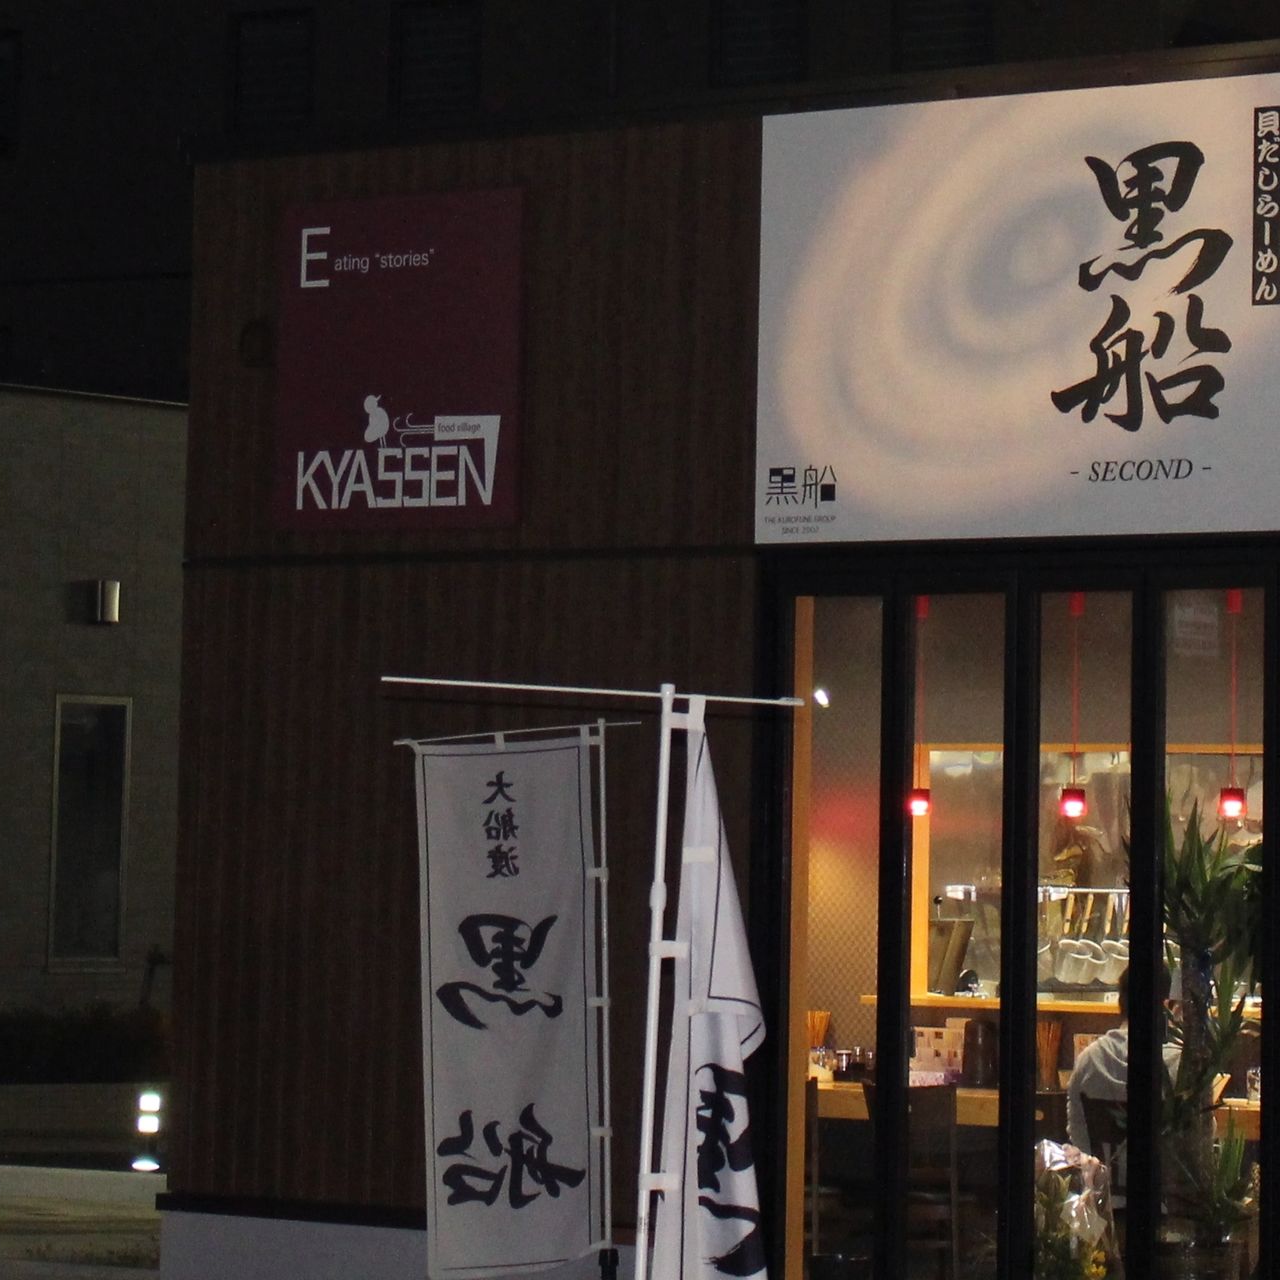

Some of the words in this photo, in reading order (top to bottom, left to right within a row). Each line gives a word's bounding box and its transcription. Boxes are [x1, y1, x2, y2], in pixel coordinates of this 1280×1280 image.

[1254, 111, 1280, 301] 貝だしらーめん
[1051, 140, 1234, 433] 黒船
[296, 444, 500, 510] KYASSEN
[765, 464, 838, 509] 黒船
[1088, 458, 1193, 483] SECOND
